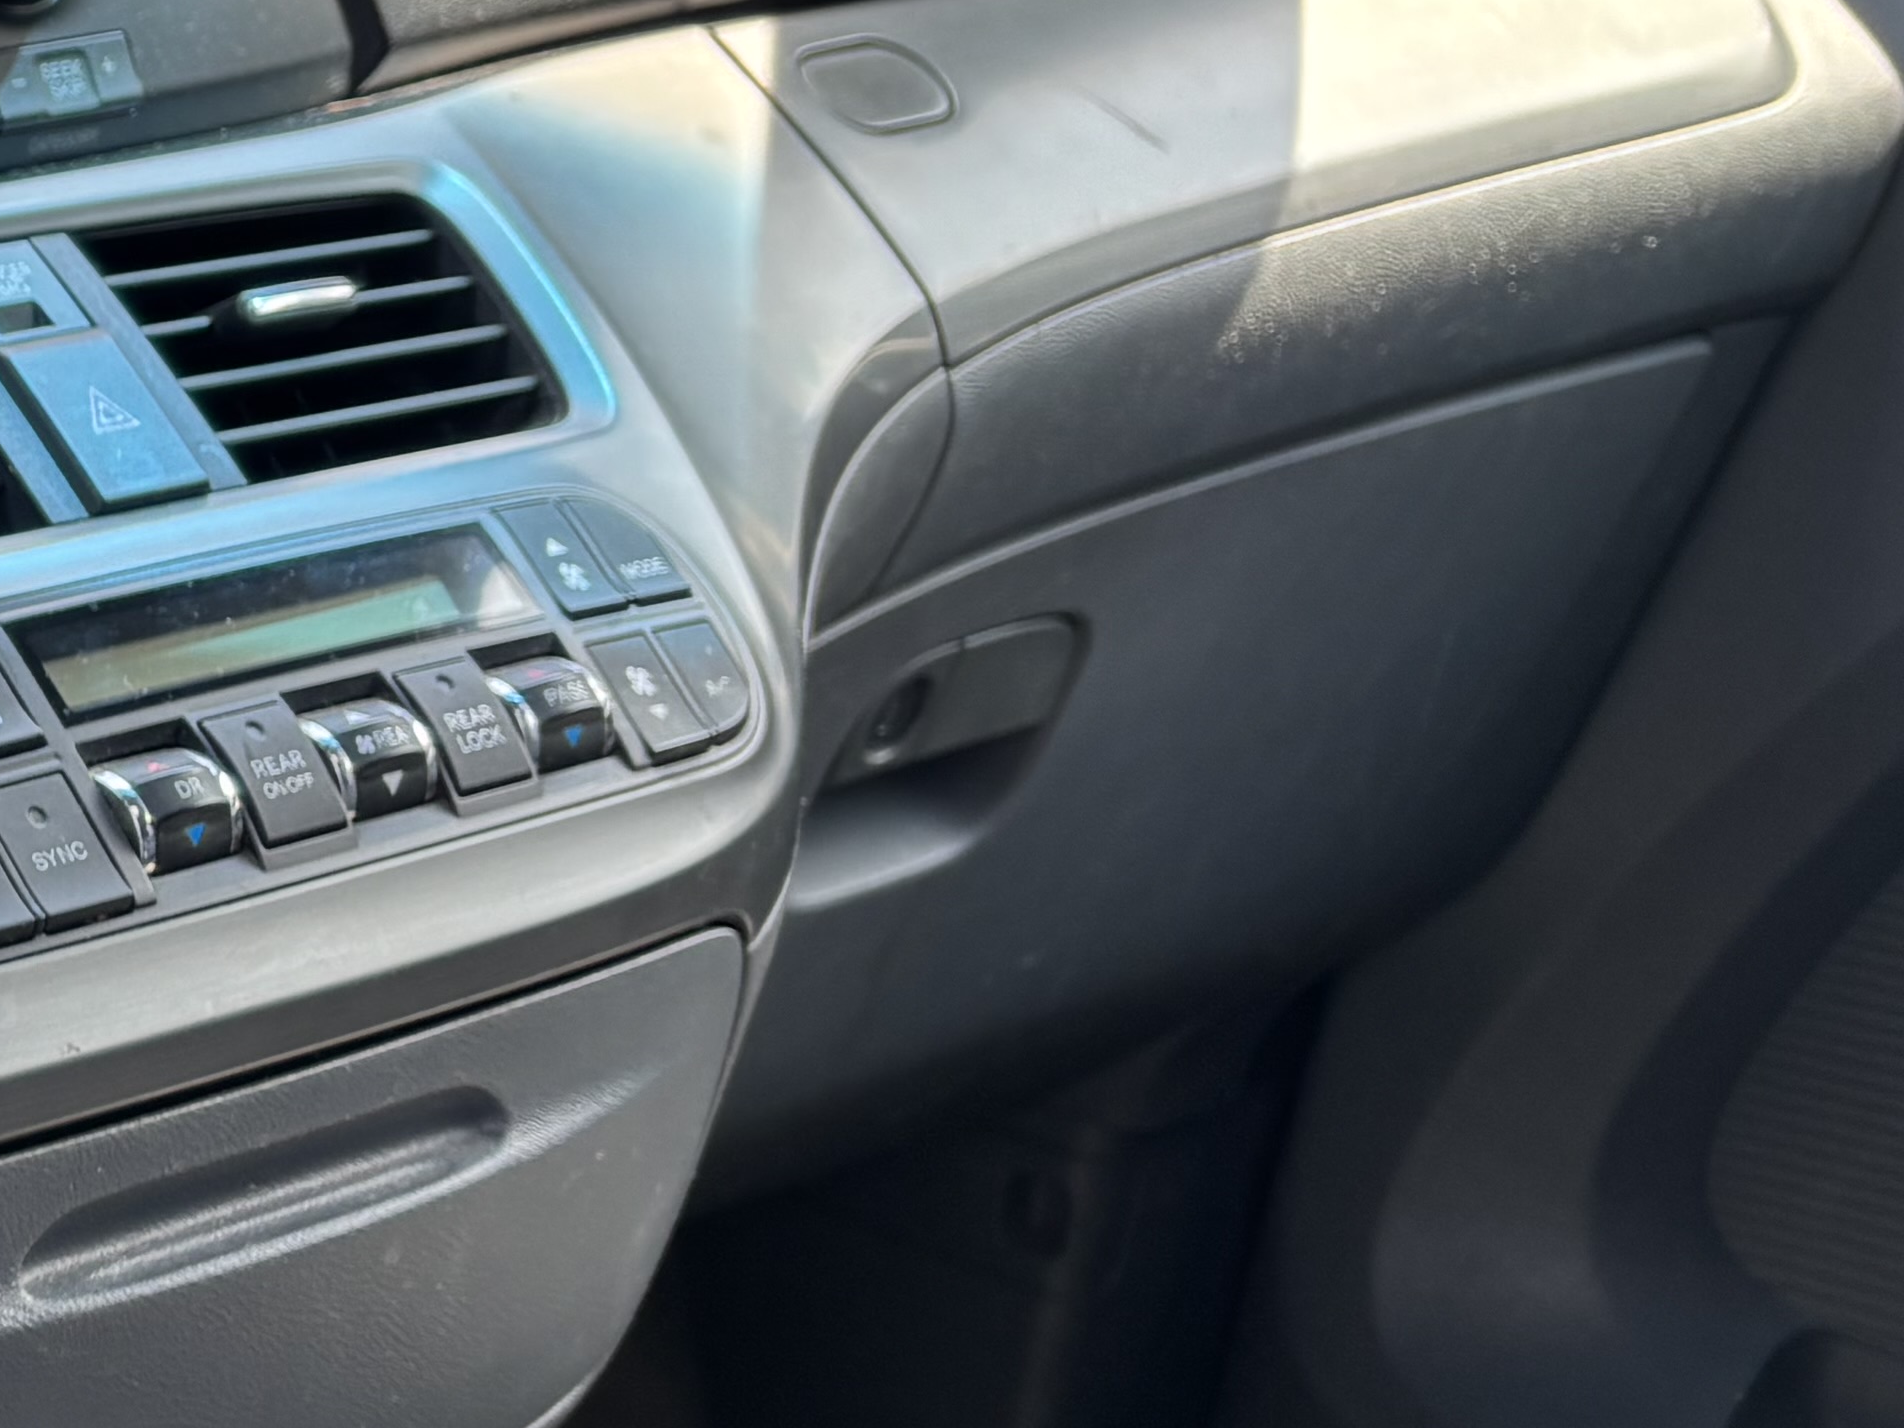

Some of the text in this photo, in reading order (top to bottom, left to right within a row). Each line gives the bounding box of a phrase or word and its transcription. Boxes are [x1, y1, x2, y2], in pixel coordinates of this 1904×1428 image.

[619, 556, 670, 581] MODE
[542, 678, 591, 708] PASS
[442, 702, 497, 734] REAR
[372, 725, 411, 751] REA
[454, 723, 508, 756] LOCK
[249, 748, 308, 780] REAR
[174, 776, 204, 803] DR
[31, 840, 90, 873] SYNC
